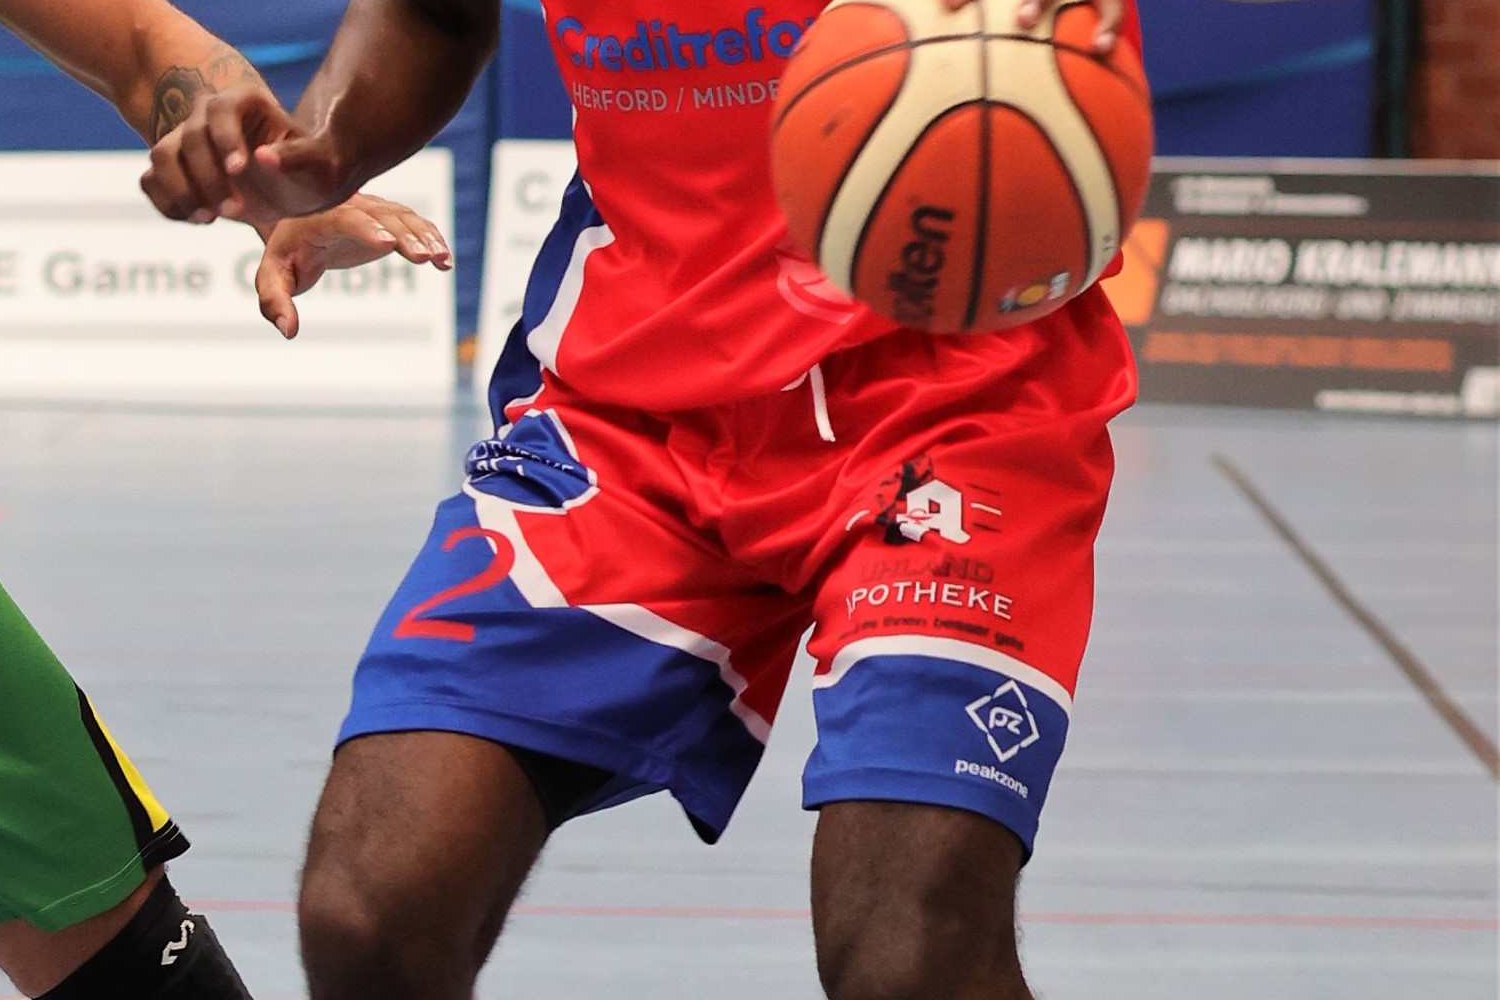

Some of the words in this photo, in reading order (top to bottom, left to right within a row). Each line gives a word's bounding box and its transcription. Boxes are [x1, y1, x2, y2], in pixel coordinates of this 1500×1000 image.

[572, 81, 669, 112] HERFORD
[692, 79, 779, 110] MINDE
[42, 250, 214, 295] Game
[393, 527, 516, 643] 2
[954, 758, 1029, 798] peakzone
